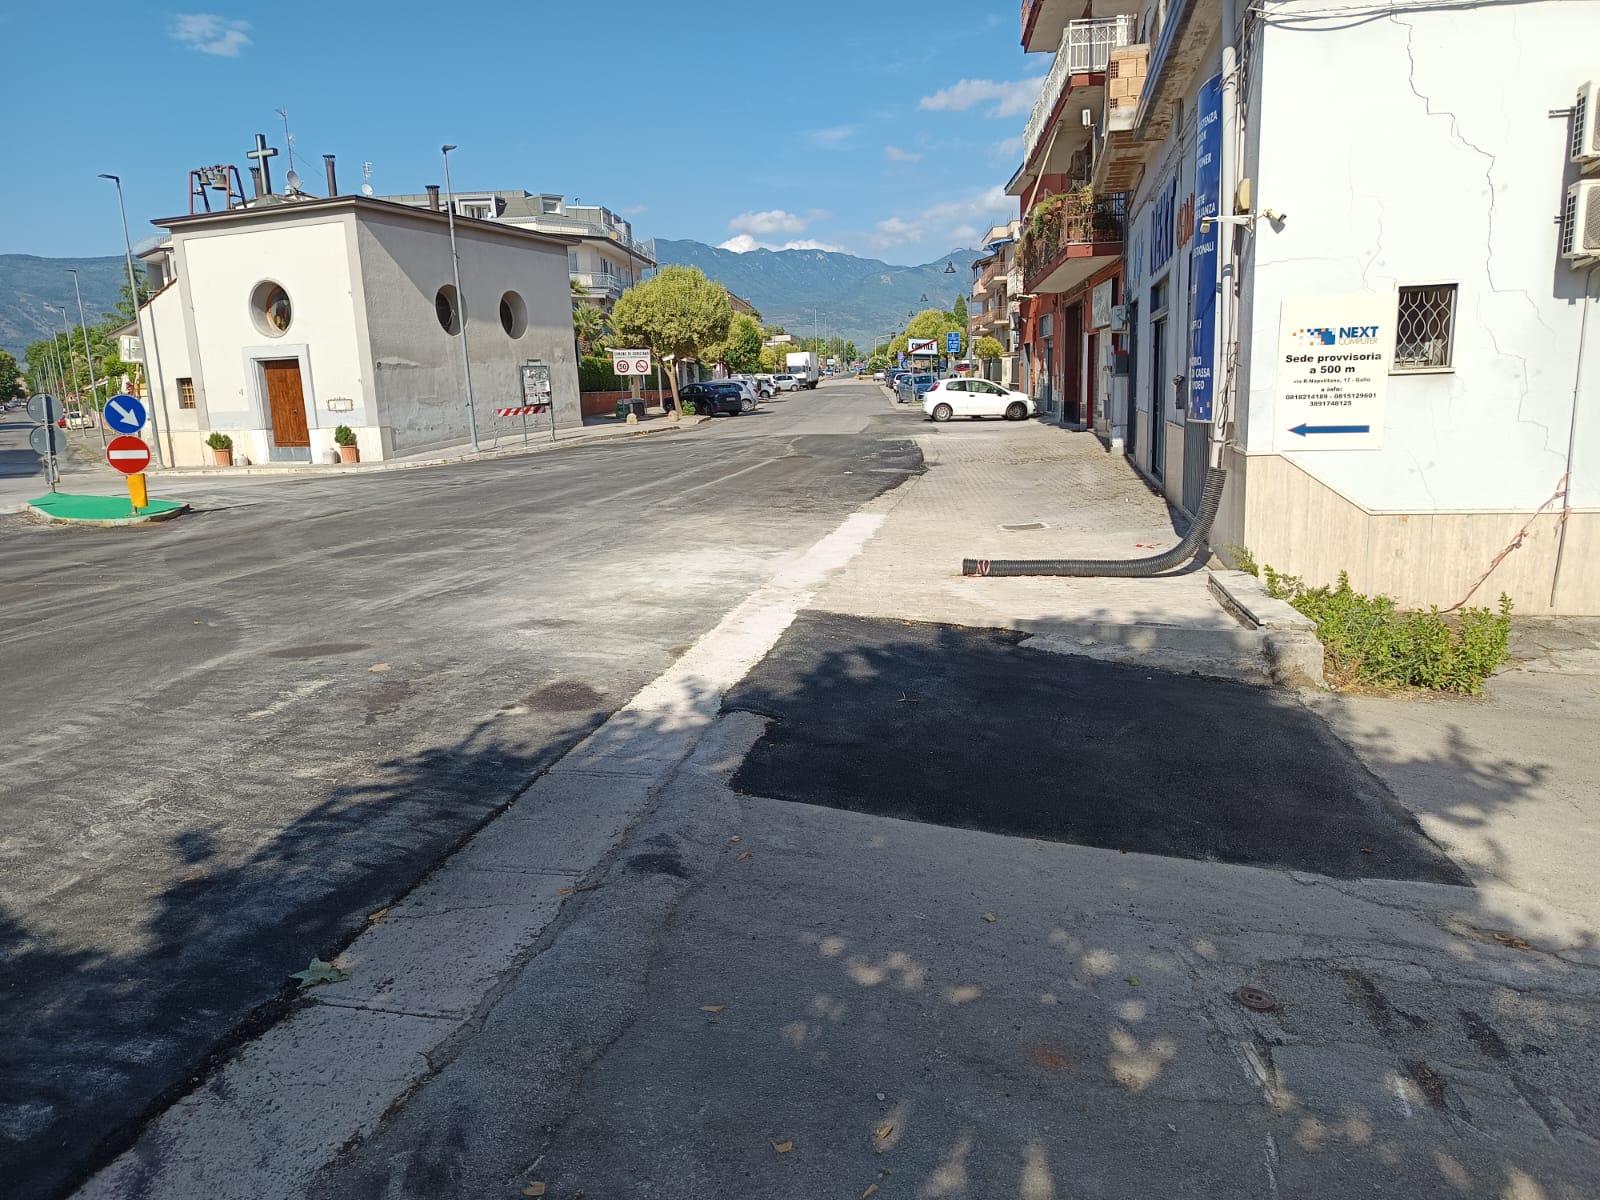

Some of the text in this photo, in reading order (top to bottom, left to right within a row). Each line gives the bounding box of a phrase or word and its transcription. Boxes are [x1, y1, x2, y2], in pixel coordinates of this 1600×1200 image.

[1150, 175, 1176, 276] NEXT
[1339, 326, 1379, 338] NEXT
[1338, 337, 1378, 345] COMPUTER
[1285, 352, 1382, 363] Sede provvisoria
[1195, 367, 1211, 378] CASSA
[1320, 365, 1341, 374] 500
